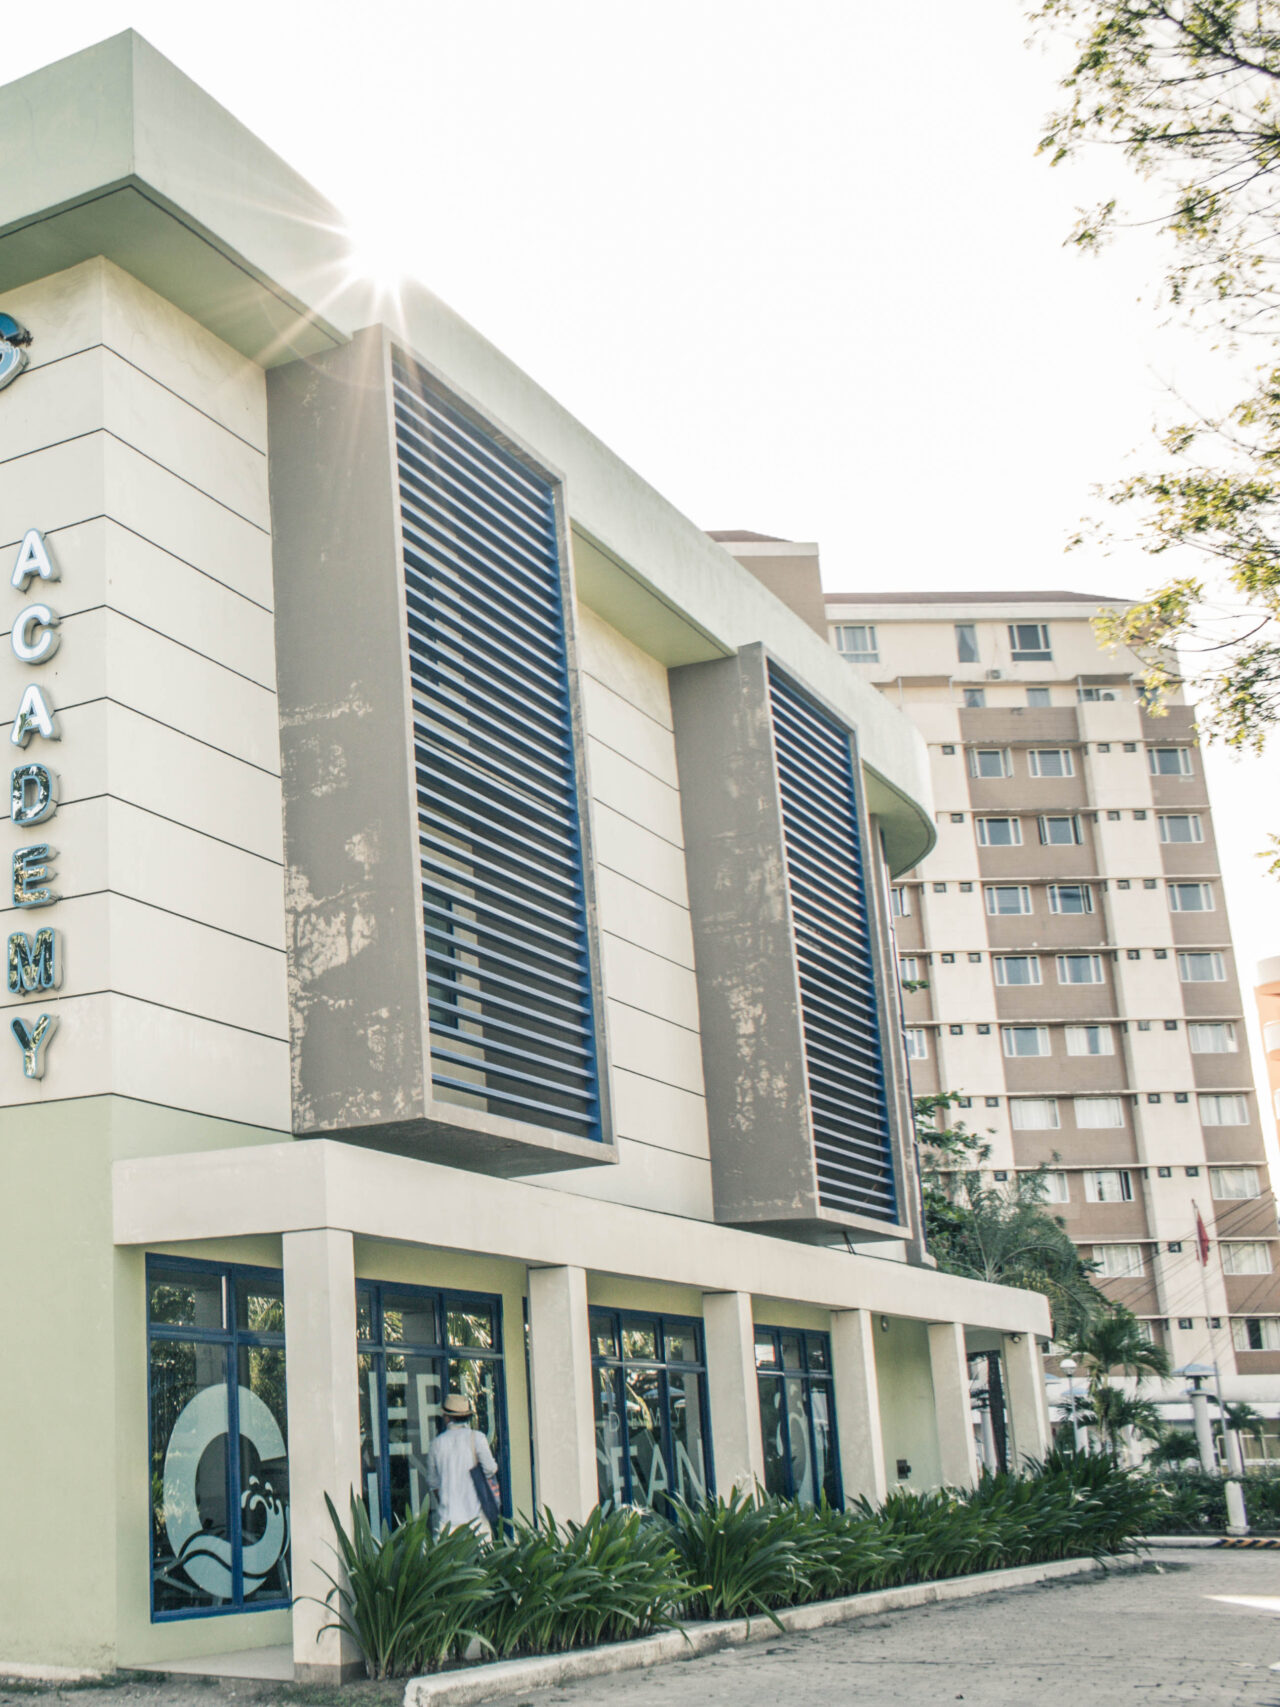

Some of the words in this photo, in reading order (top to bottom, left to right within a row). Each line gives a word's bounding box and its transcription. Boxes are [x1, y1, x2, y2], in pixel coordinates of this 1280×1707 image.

[8, 528, 62, 1079] ACADEMY
[360, 1371, 495, 1456] ERU
[596, 1439, 707, 1513] EAN
